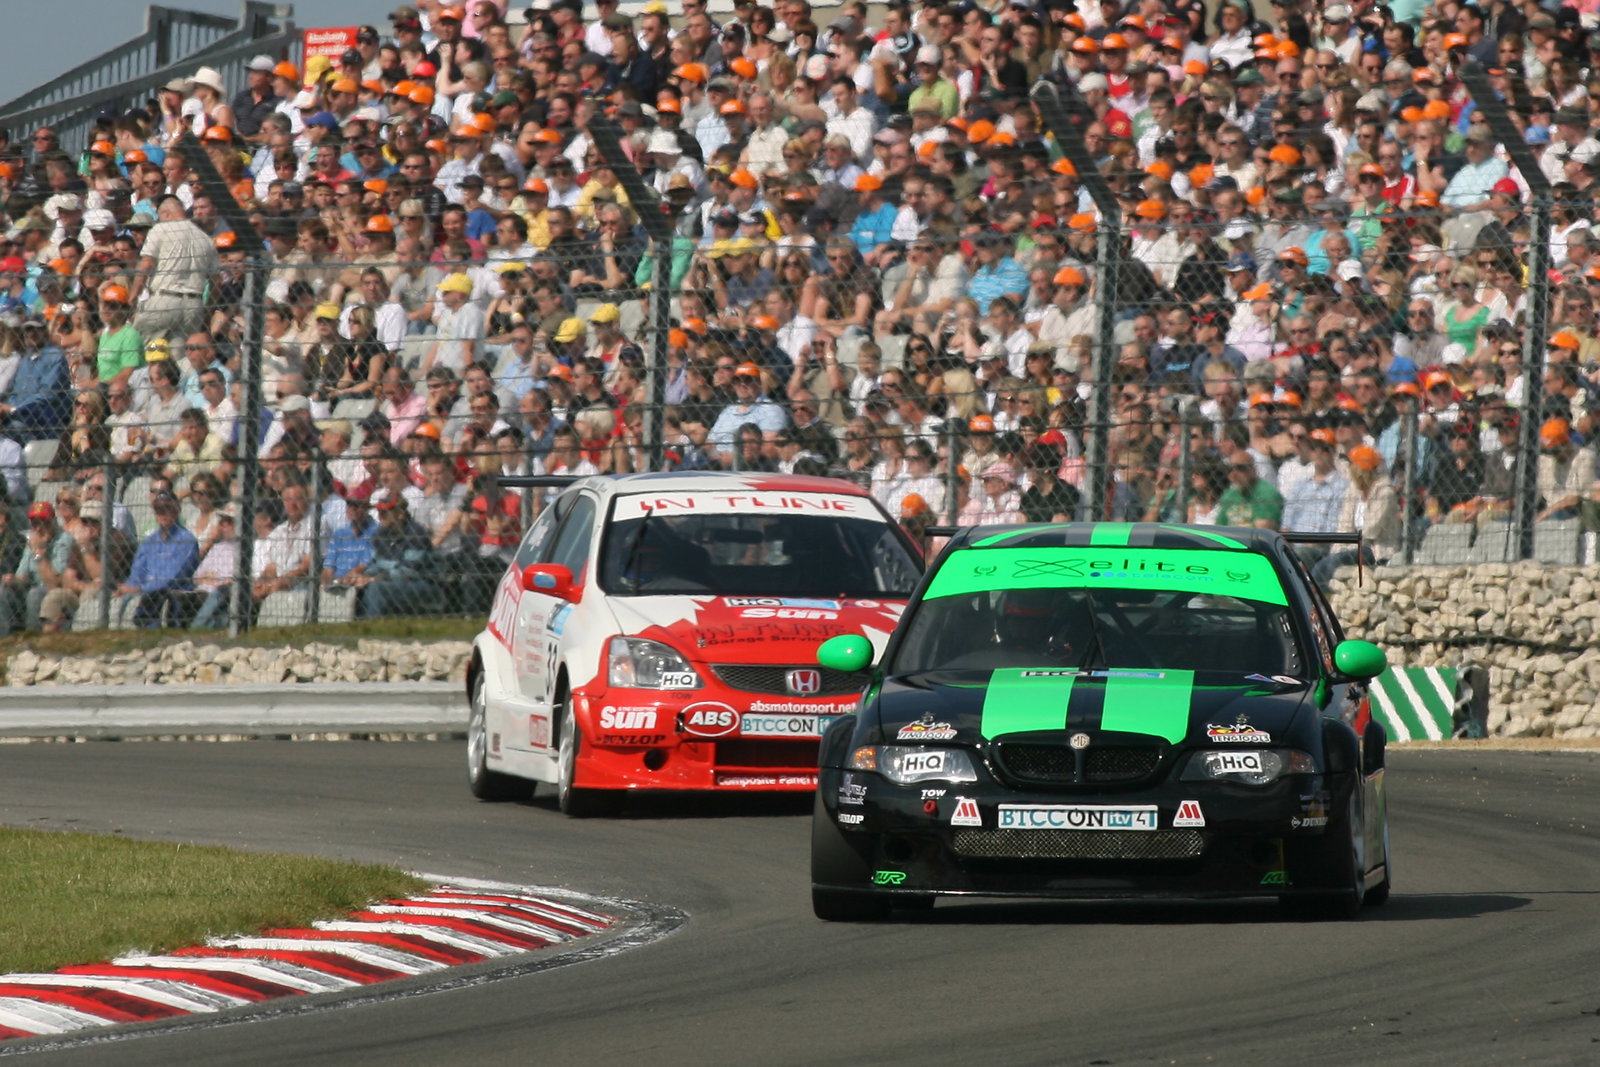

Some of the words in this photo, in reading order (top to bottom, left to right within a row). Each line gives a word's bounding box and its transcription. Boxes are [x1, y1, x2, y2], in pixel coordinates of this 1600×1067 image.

[640, 497, 695, 511] IN
[713, 497, 857, 512] TUNE
[1089, 558, 1209, 575] elite
[739, 608, 838, 620] Sun
[707, 635, 766, 646] Garage
[663, 675, 693, 686] HiQ
[600, 705, 658, 729] Sun
[689, 711, 732, 726] ABS
[603, 735, 666, 744] DUNLOP
[905, 755, 942, 771] HiQ
[1222, 755, 1259, 770] HiQ
